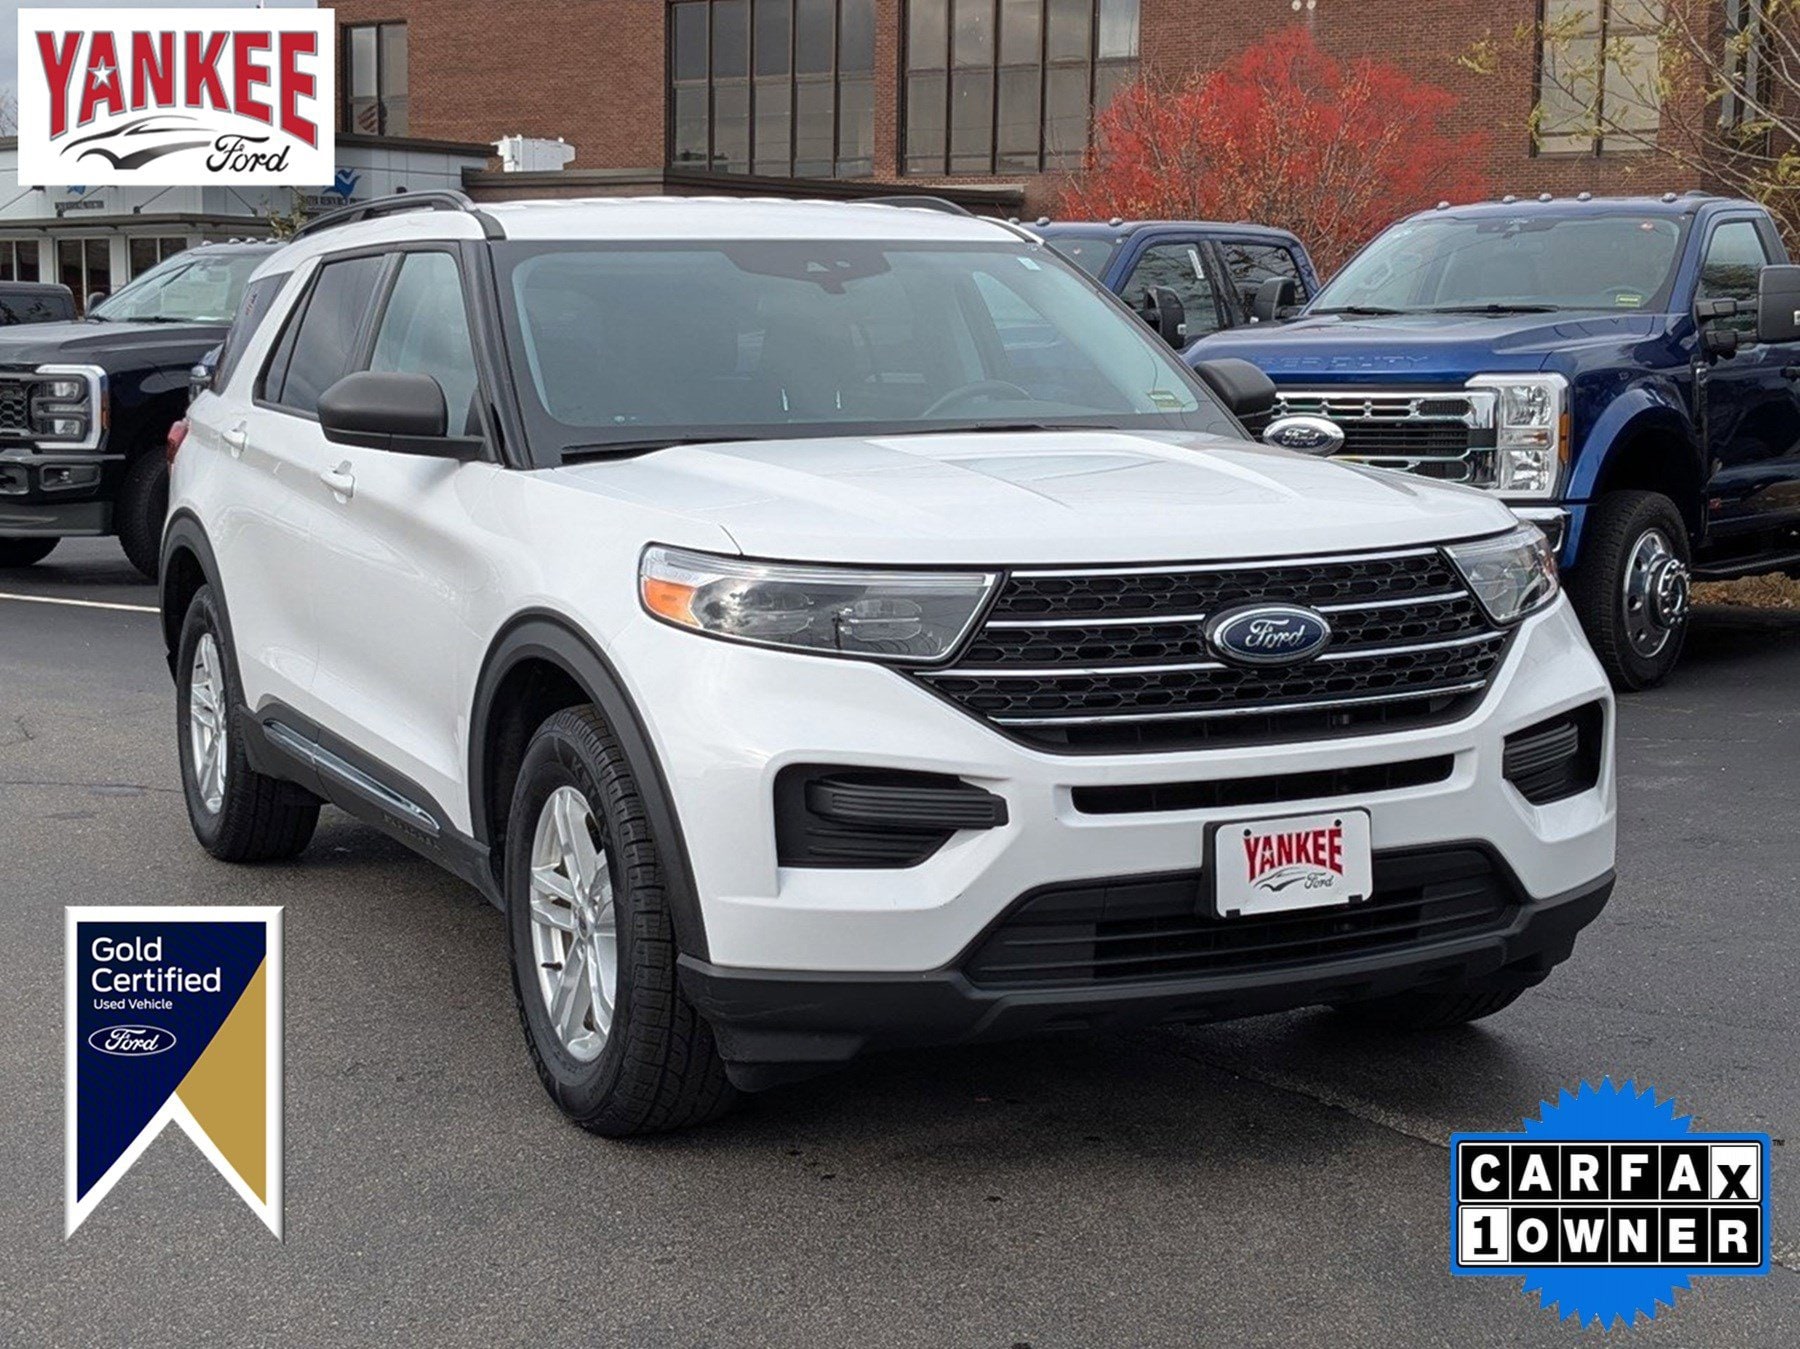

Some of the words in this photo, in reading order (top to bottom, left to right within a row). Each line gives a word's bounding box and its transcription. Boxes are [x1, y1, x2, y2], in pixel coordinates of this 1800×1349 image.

[1245, 619, 1306, 648] Ford
[1243, 828, 1343, 883] YANKEE
[1304, 872, 1335, 890] Ford
